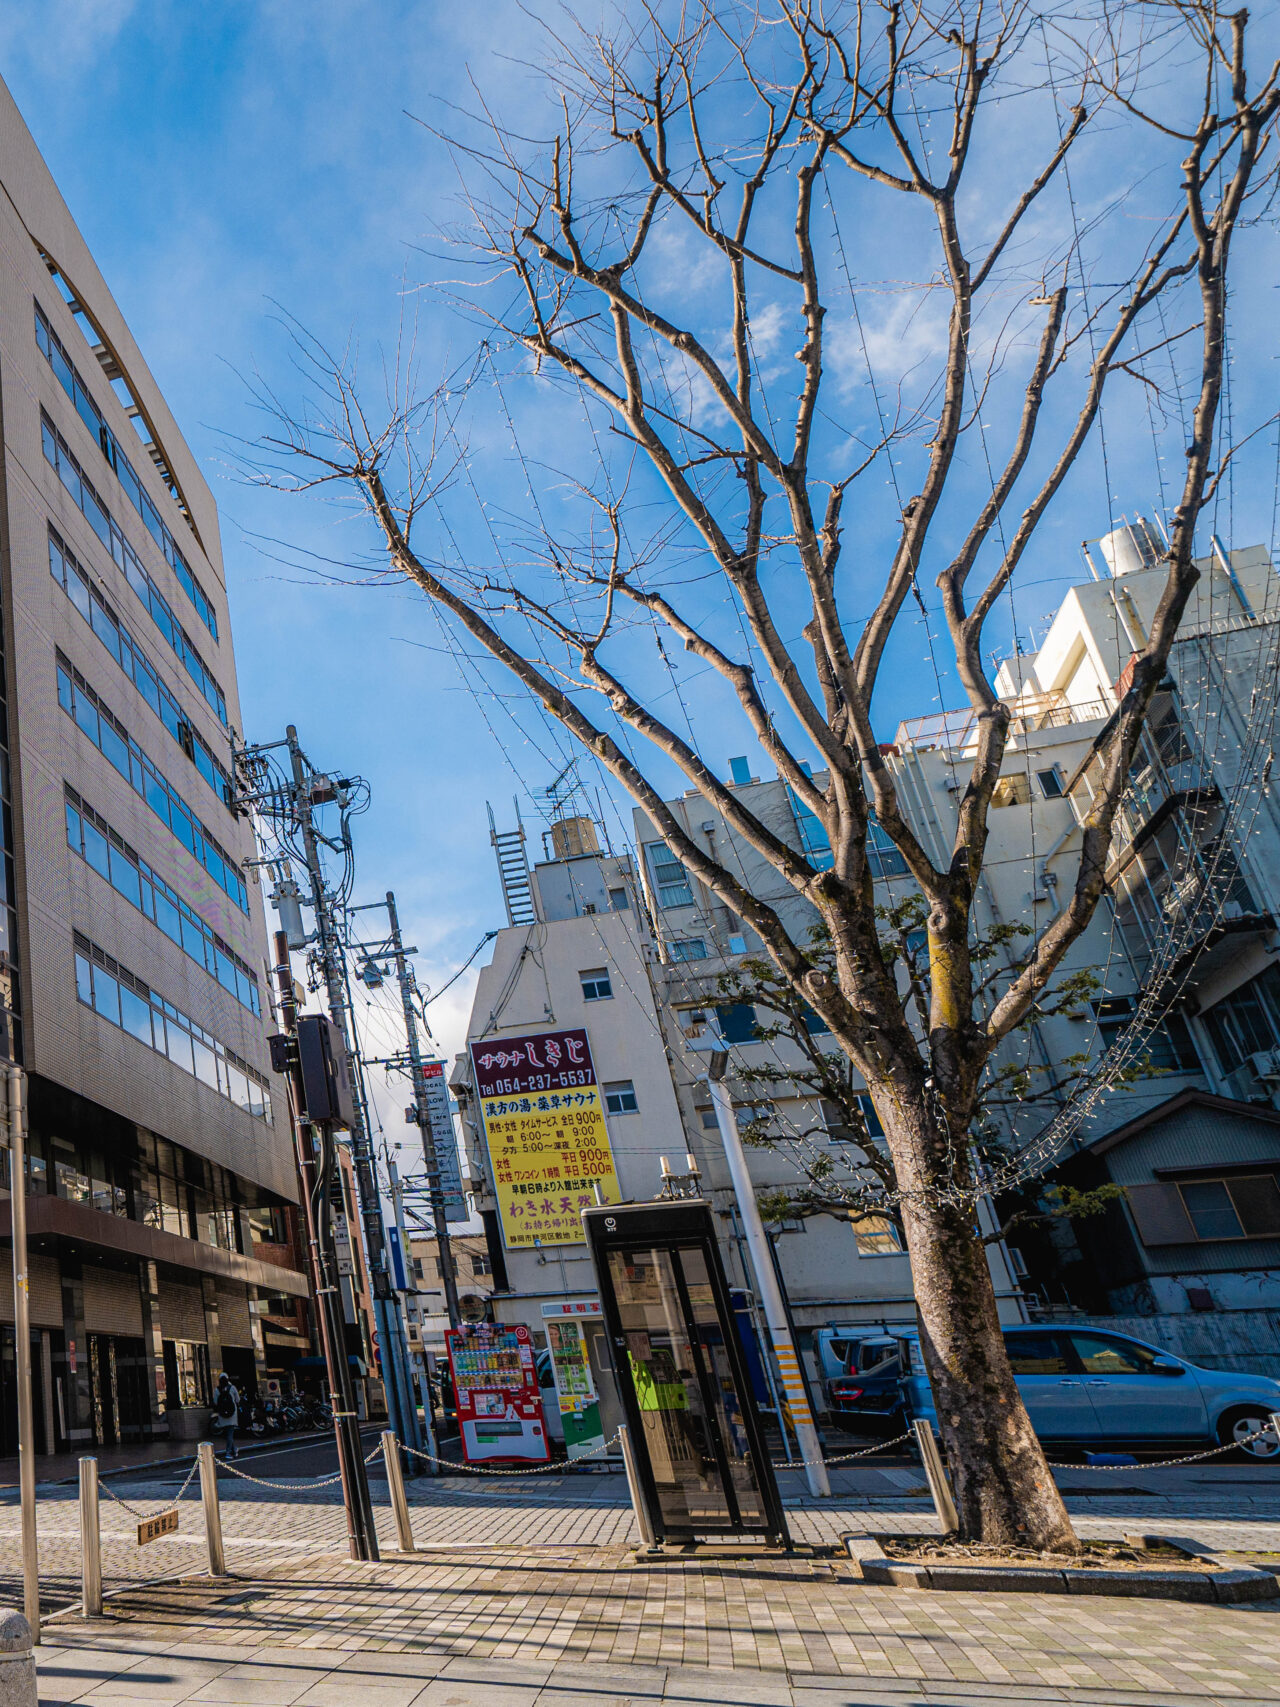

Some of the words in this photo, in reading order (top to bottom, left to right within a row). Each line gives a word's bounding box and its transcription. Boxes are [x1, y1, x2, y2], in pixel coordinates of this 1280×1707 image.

[481, 1084, 494, 1096] Tel
[496, 1069, 592, 1094] 054-237-5537
[486, 1092, 596, 1117] 漢方の湯・薬草サウナ
[489, 1121, 517, 1134] 男性・女性
[576, 1111, 601, 1125] 900円
[573, 1126, 594, 1136] 9:00
[575, 1137, 596, 1148] 2:00
[496, 1158, 511, 1169] 女性
[561, 1152, 577, 1163] 平日
[579, 1148, 609, 1161] 900円
[498, 1171, 513, 1183] 女性
[514, 1169, 539, 1180] ワンコイン
[564, 1165, 580, 1177] 平日
[582, 1162, 612, 1175] 500円
[509, 1194, 610, 1218] わき水天然
